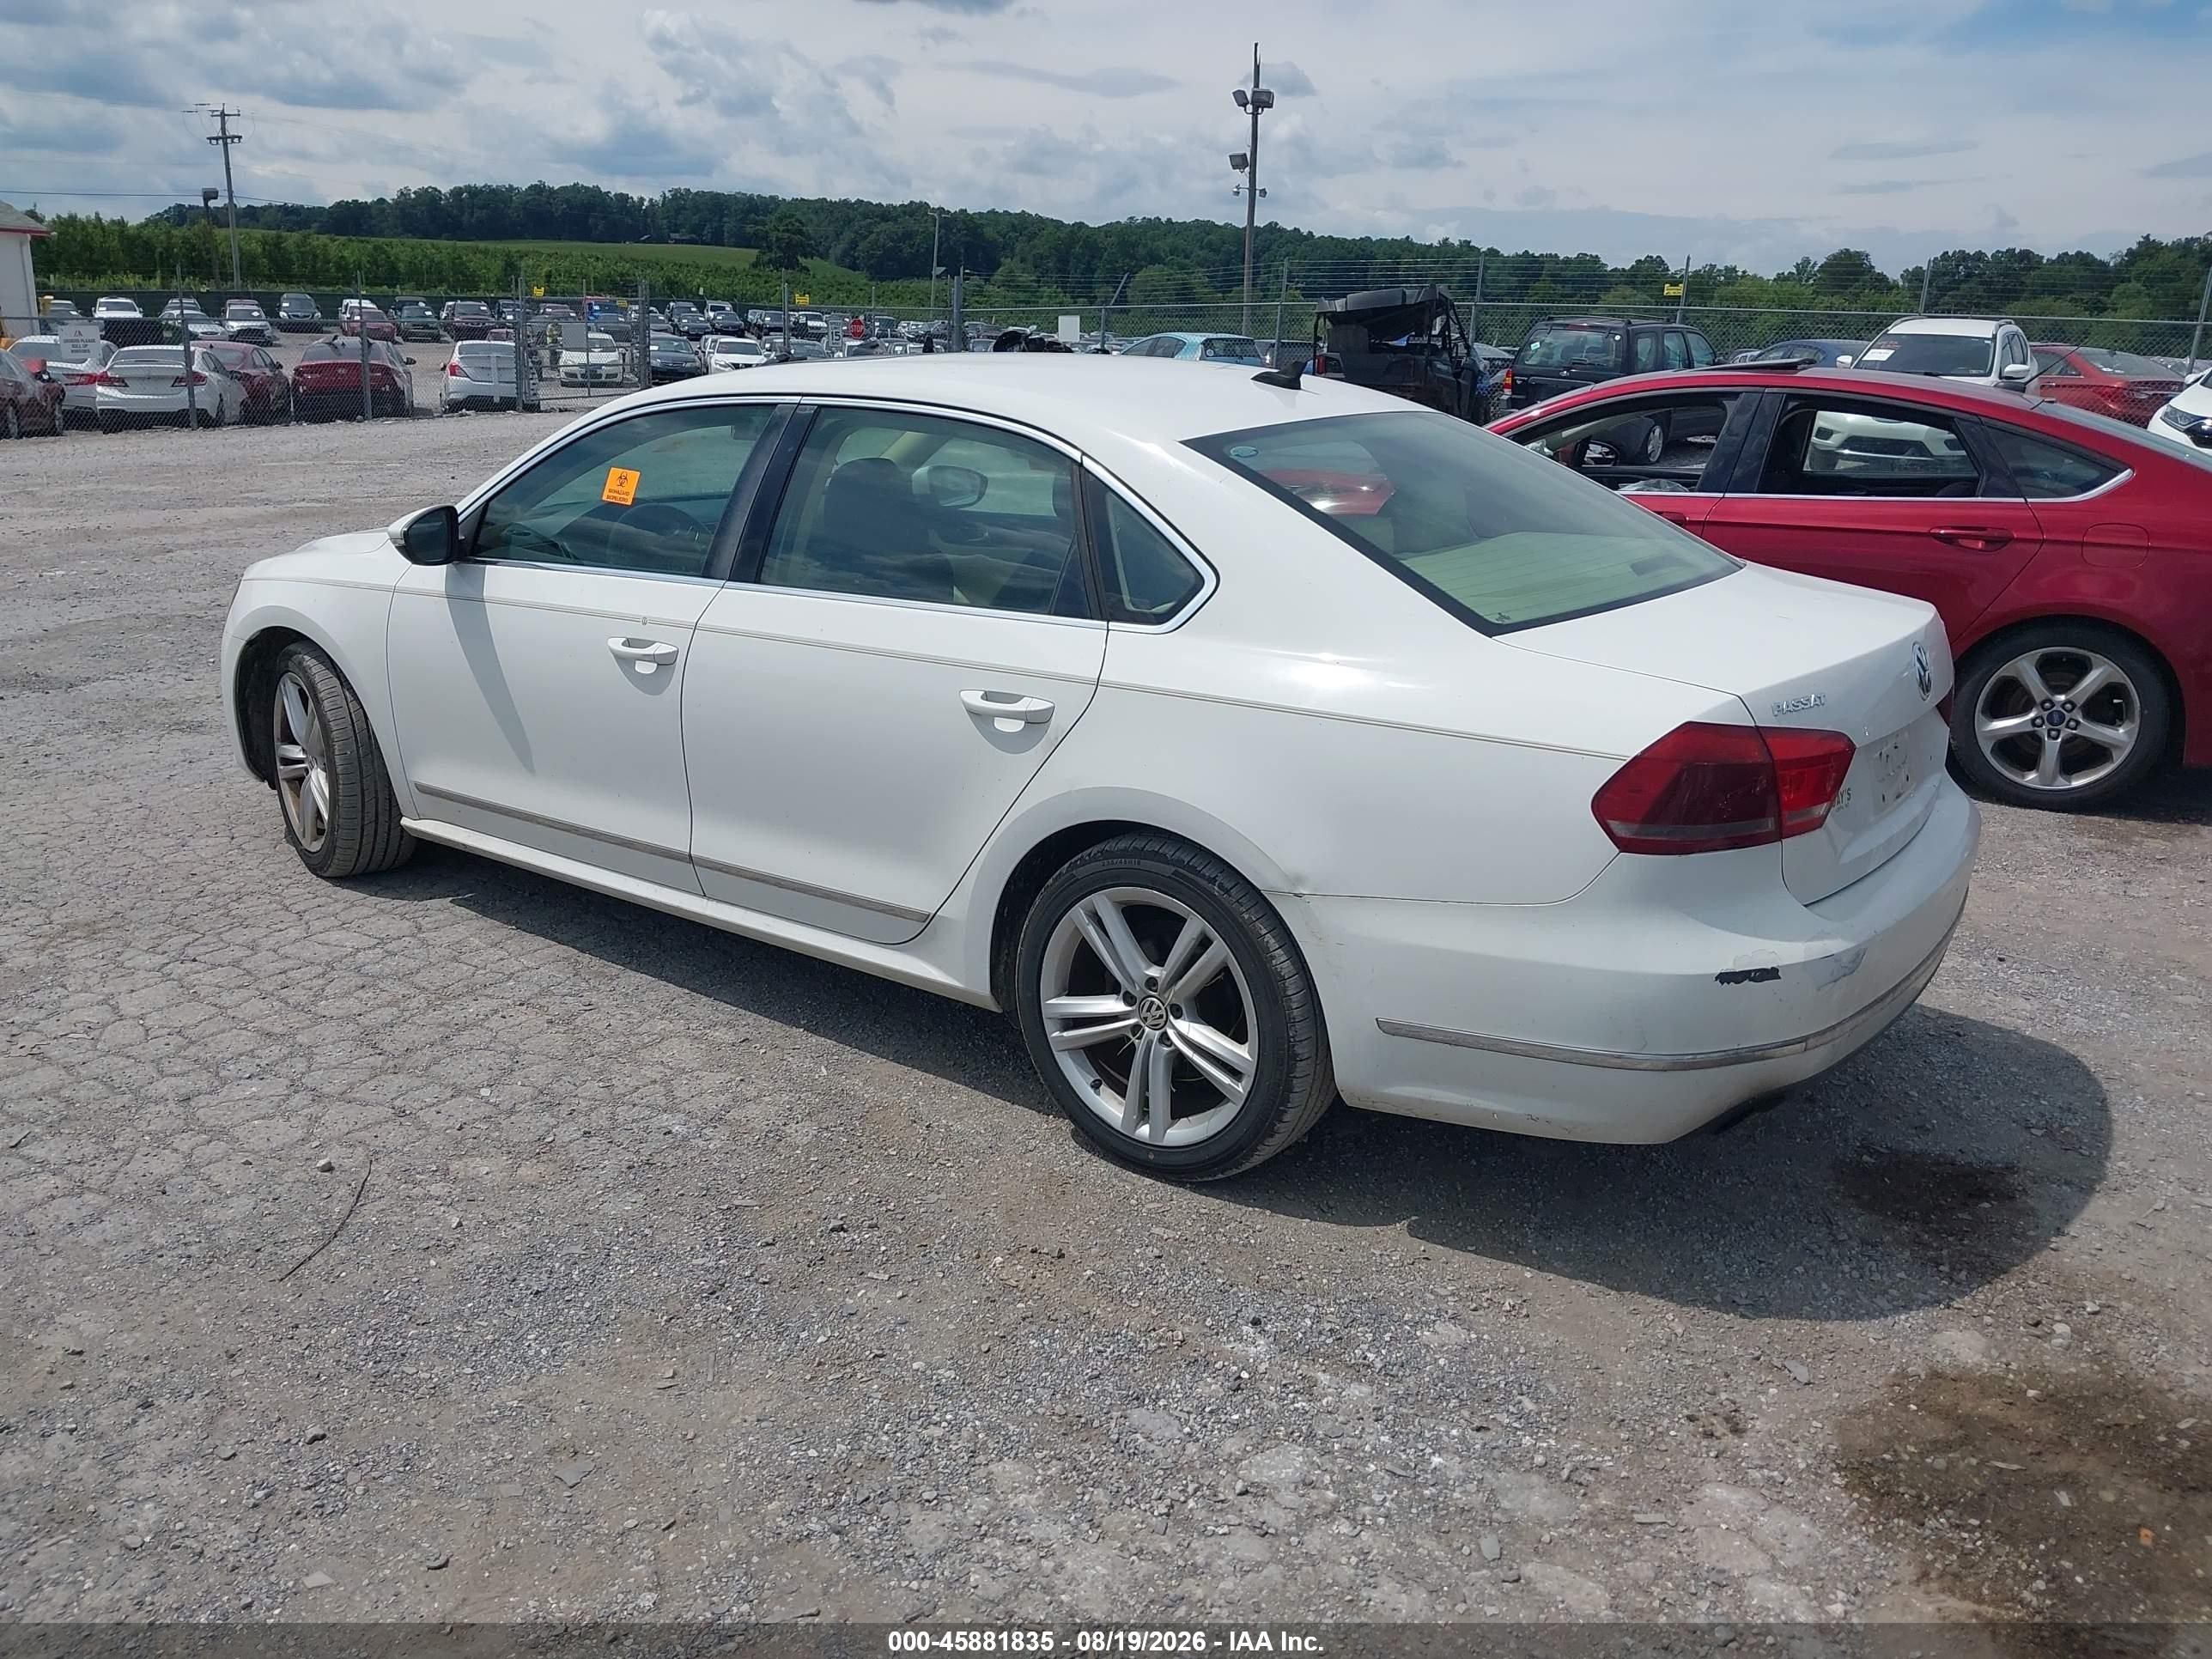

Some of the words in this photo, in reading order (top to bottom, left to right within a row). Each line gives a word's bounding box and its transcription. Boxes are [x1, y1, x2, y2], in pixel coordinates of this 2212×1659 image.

[851, 325, 864, 333] STOP
[830, 331, 842, 342] 15
[1771, 693, 1826, 717] PASSAT
